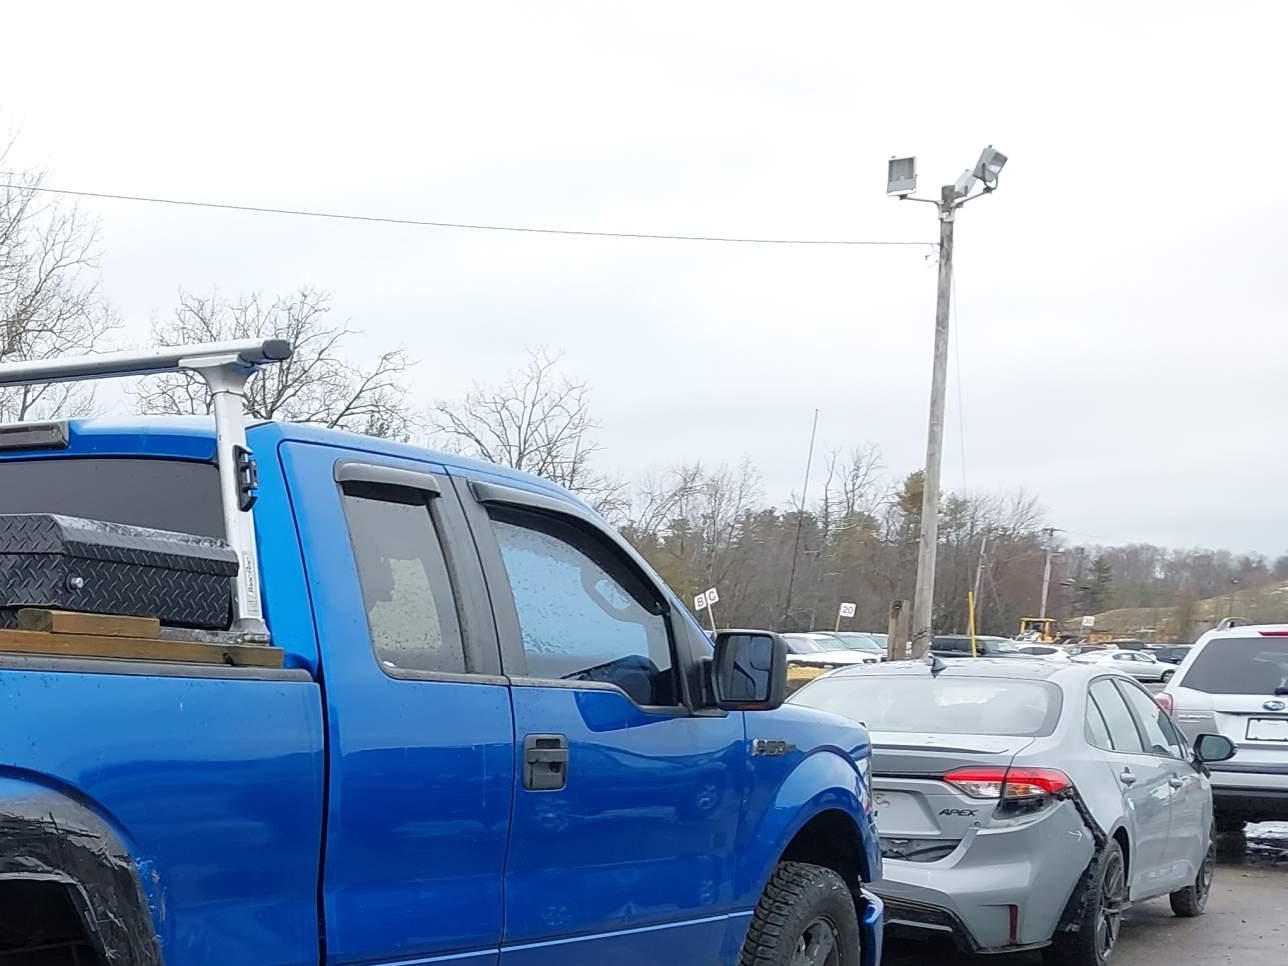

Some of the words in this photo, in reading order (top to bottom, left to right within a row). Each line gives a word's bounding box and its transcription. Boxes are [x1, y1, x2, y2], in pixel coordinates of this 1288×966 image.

[708, 590, 717, 602] C
[696, 596, 705, 608] B
[842, 605, 854, 615] 20
[938, 808, 980, 817] APEX
